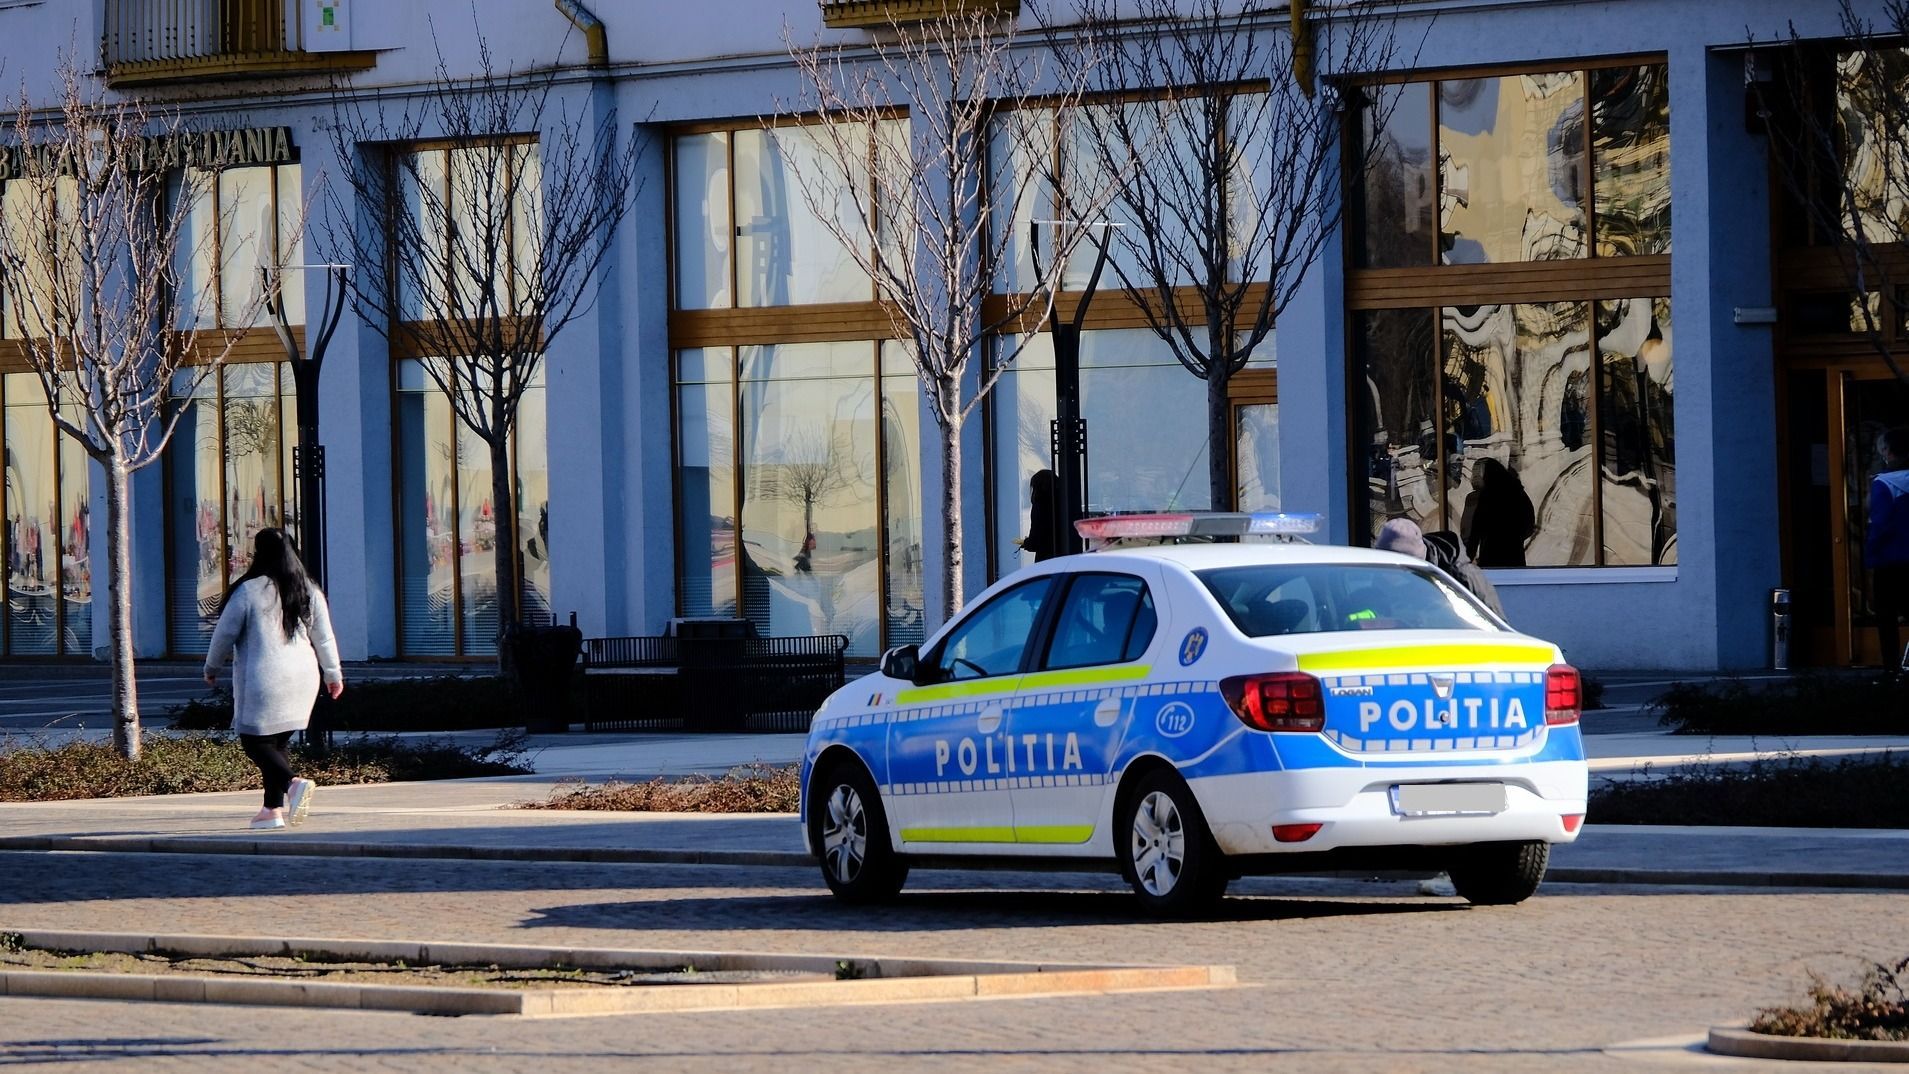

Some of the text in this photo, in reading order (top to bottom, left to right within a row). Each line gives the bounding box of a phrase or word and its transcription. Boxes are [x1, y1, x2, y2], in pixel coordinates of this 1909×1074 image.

[117, 126, 290, 170] RANSILVANIA
[1331, 687, 1372, 696] LOGAN
[1167, 714, 1187, 731] 112
[1359, 697, 1527, 732] POLITIA
[935, 732, 1084, 777] POLITIA
